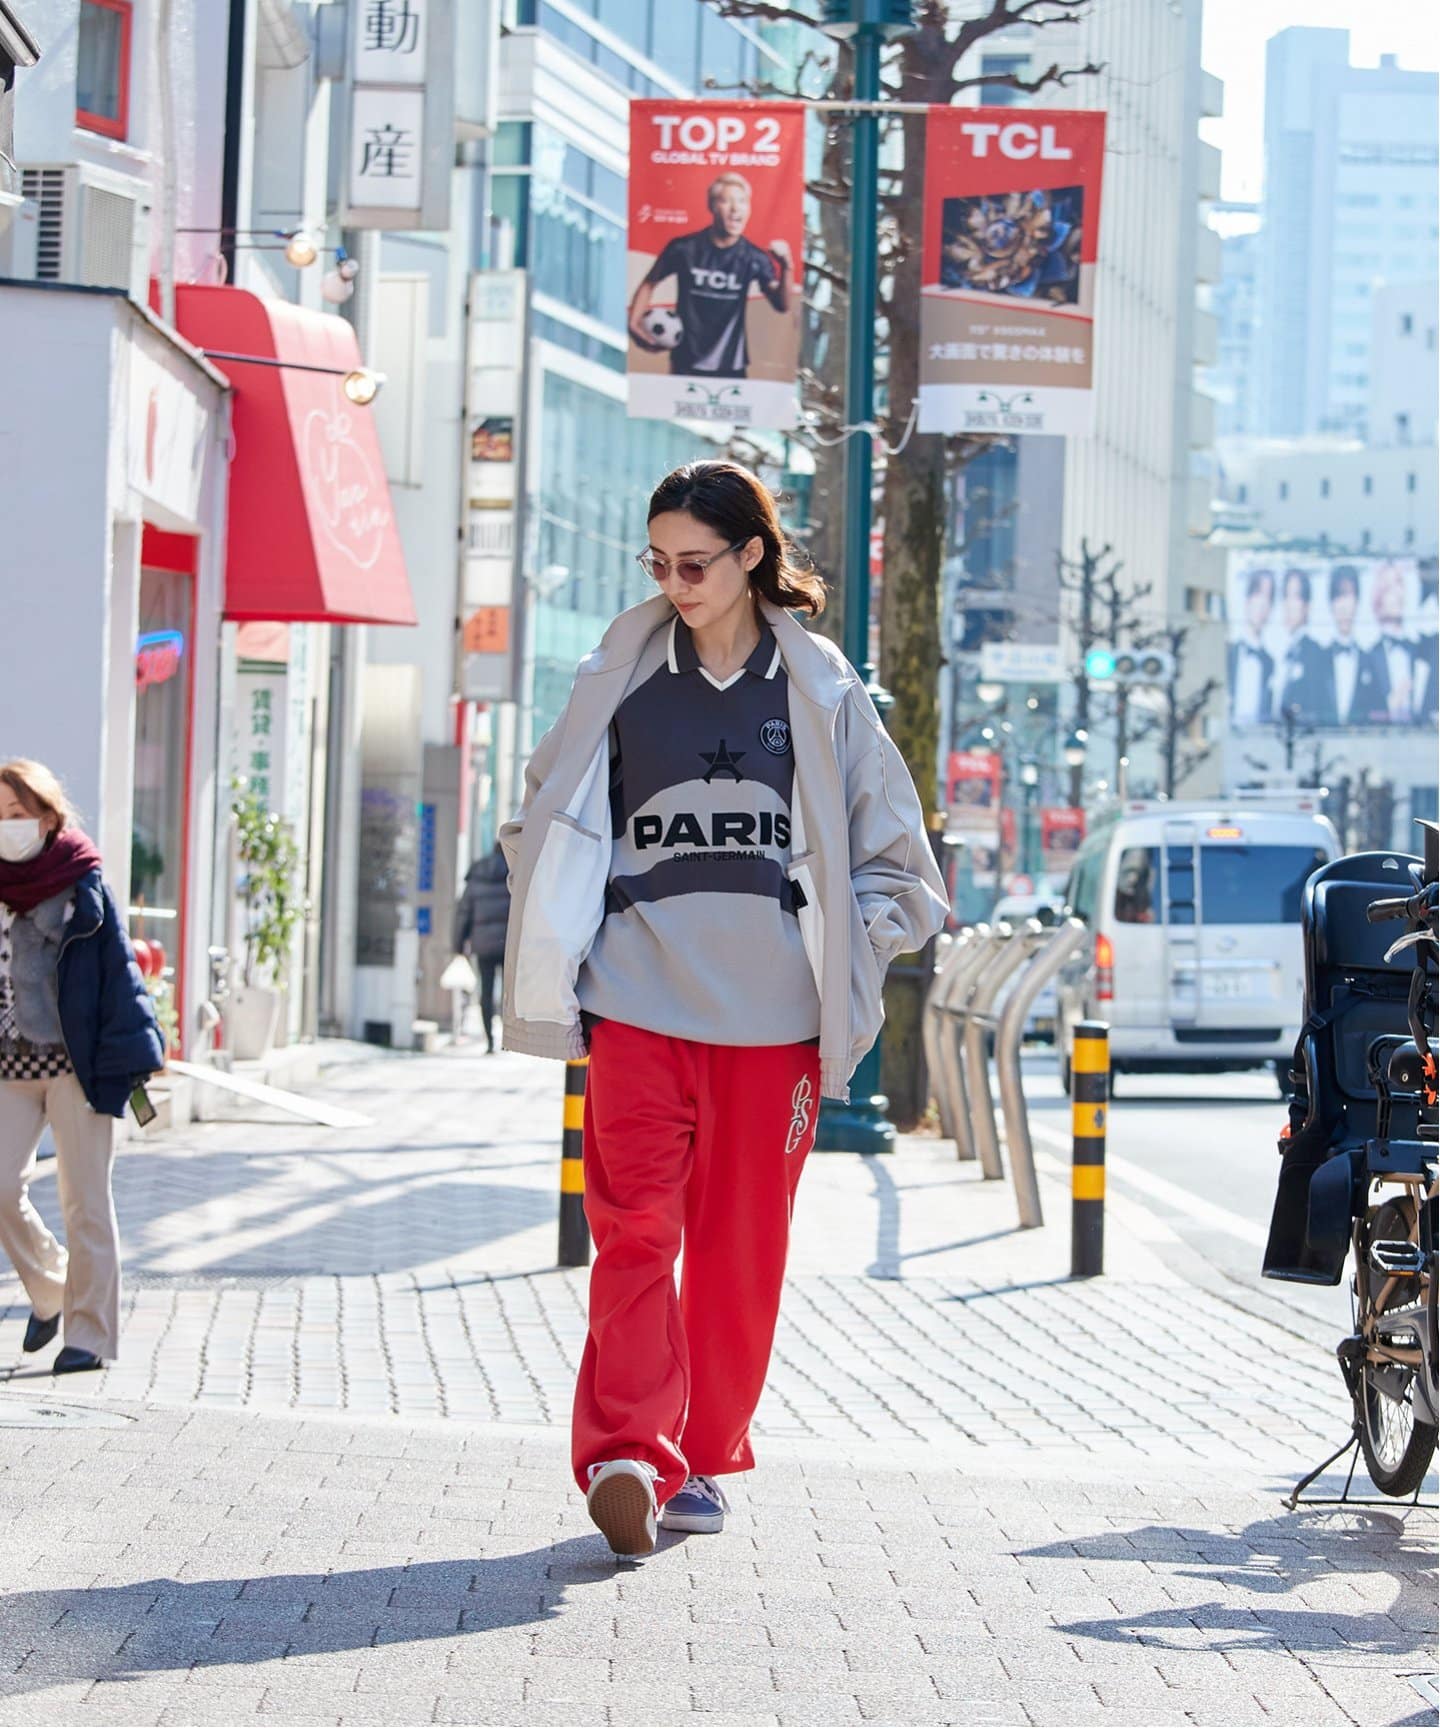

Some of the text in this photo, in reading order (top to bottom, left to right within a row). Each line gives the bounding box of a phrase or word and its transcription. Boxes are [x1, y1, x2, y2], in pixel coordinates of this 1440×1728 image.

[652, 115, 781, 152] TOP 2
[961, 123, 1072, 160] TCL
[651, 151, 780, 167] GLOBAL TV BRAND
[691, 267, 742, 290] TCL
[251, 689, 271, 815] 賃貸・事務
[634, 812, 791, 850] PARIS
[673, 850, 766, 863] SAINT-GERMAIN
